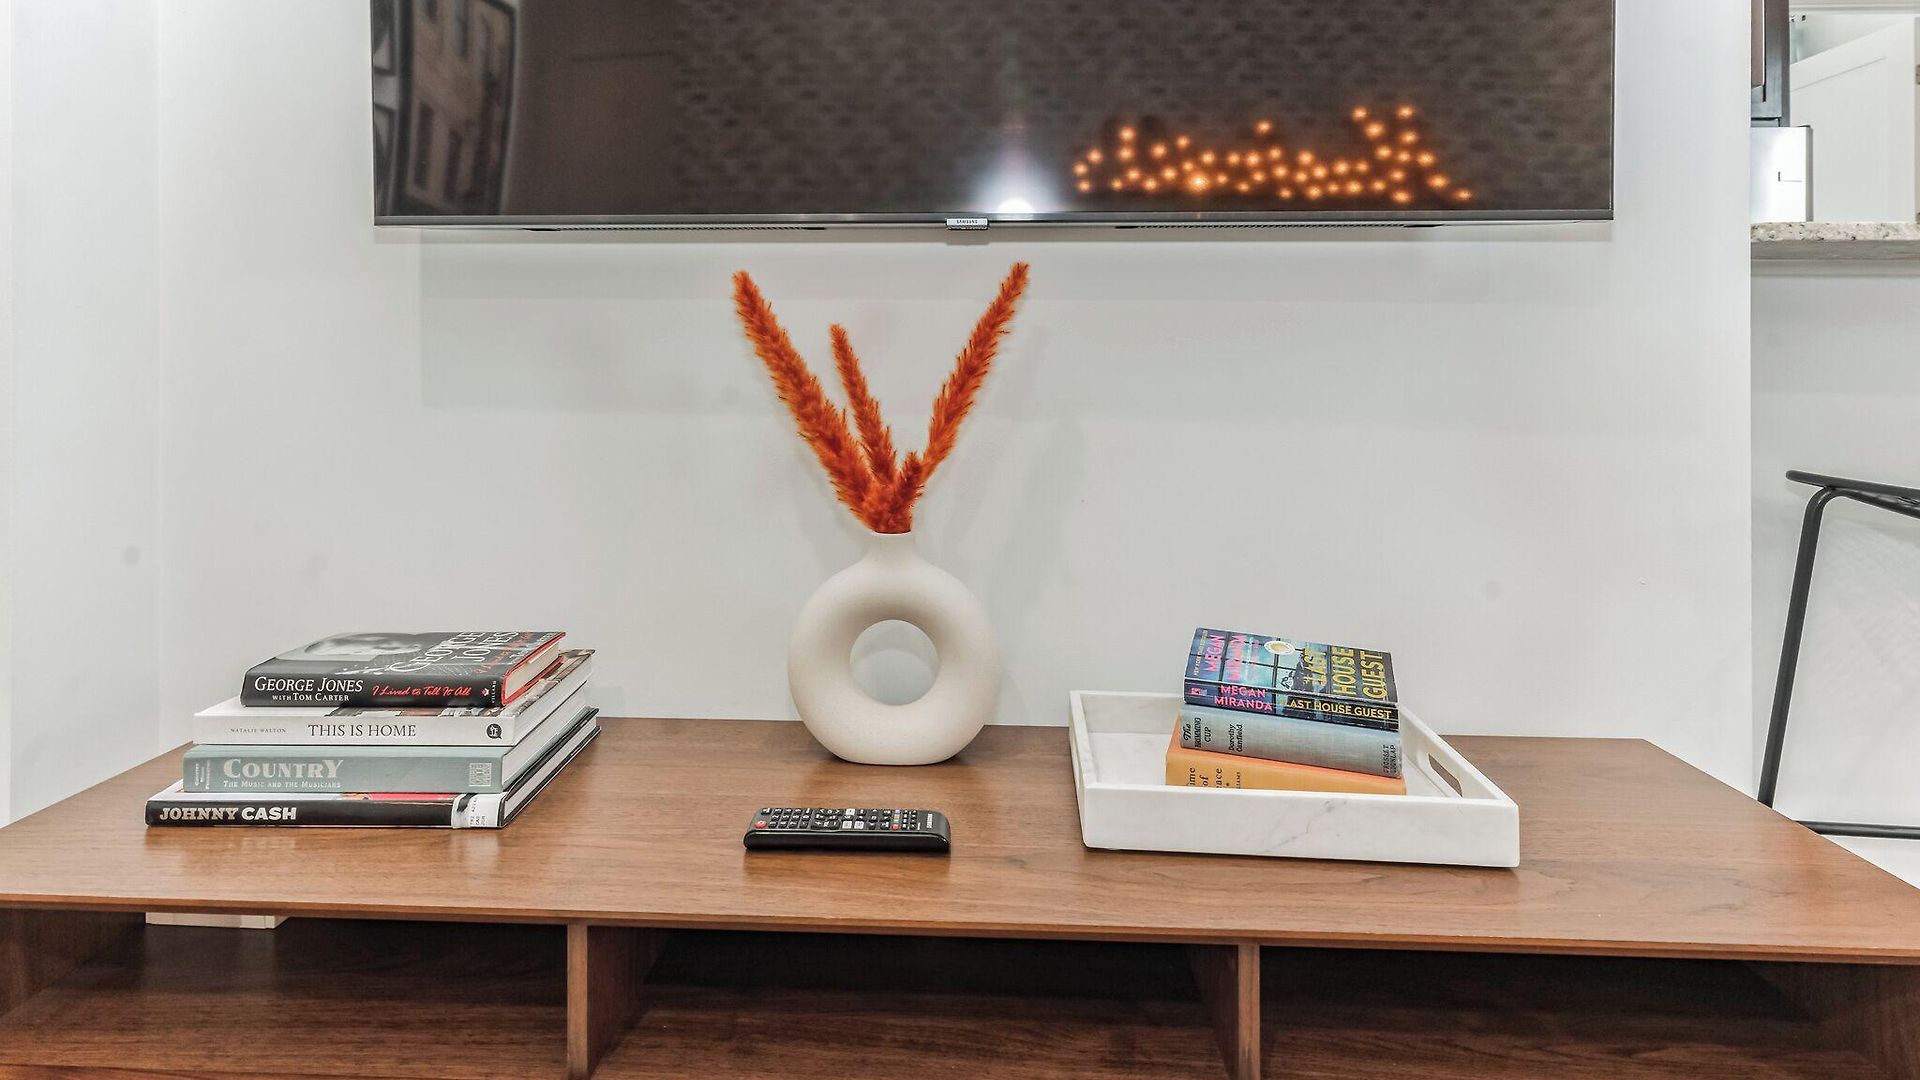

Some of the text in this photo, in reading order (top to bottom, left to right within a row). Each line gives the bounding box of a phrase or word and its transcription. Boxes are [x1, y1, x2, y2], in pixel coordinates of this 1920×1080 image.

[1203, 635, 1225, 672] MEGAN
[1331, 646, 1357, 695] HOUSE
[1359, 650, 1388, 699] GUEST
[254, 676, 364, 693] GEORGE JONES
[411, 688, 421, 696] to
[423, 685, 442, 696] Tell
[442, 686, 453, 697] It
[454, 686, 472, 696] All
[1220, 684, 1266, 698] MEGAN
[293, 692, 313, 701] TOM
[315, 692, 350, 702] CARTER
[1214, 696, 1273, 711] MIRANDA
[1314, 701, 1353, 715] HOUSE
[1354, 706, 1392, 720] GUEST
[307, 724, 417, 737] THIS IS HOME
[1182, 723, 1192, 741] The
[1204, 726, 1212, 743] CUP
[1228, 724, 1237, 751] Dorothy
[223, 758, 344, 779] COUNTRY
[1187, 767, 1196, 786] ime
[1199, 774, 1209, 786] of
[1215, 768, 1223, 788] ace
[159, 806, 297, 821] JOHNNY CASH
